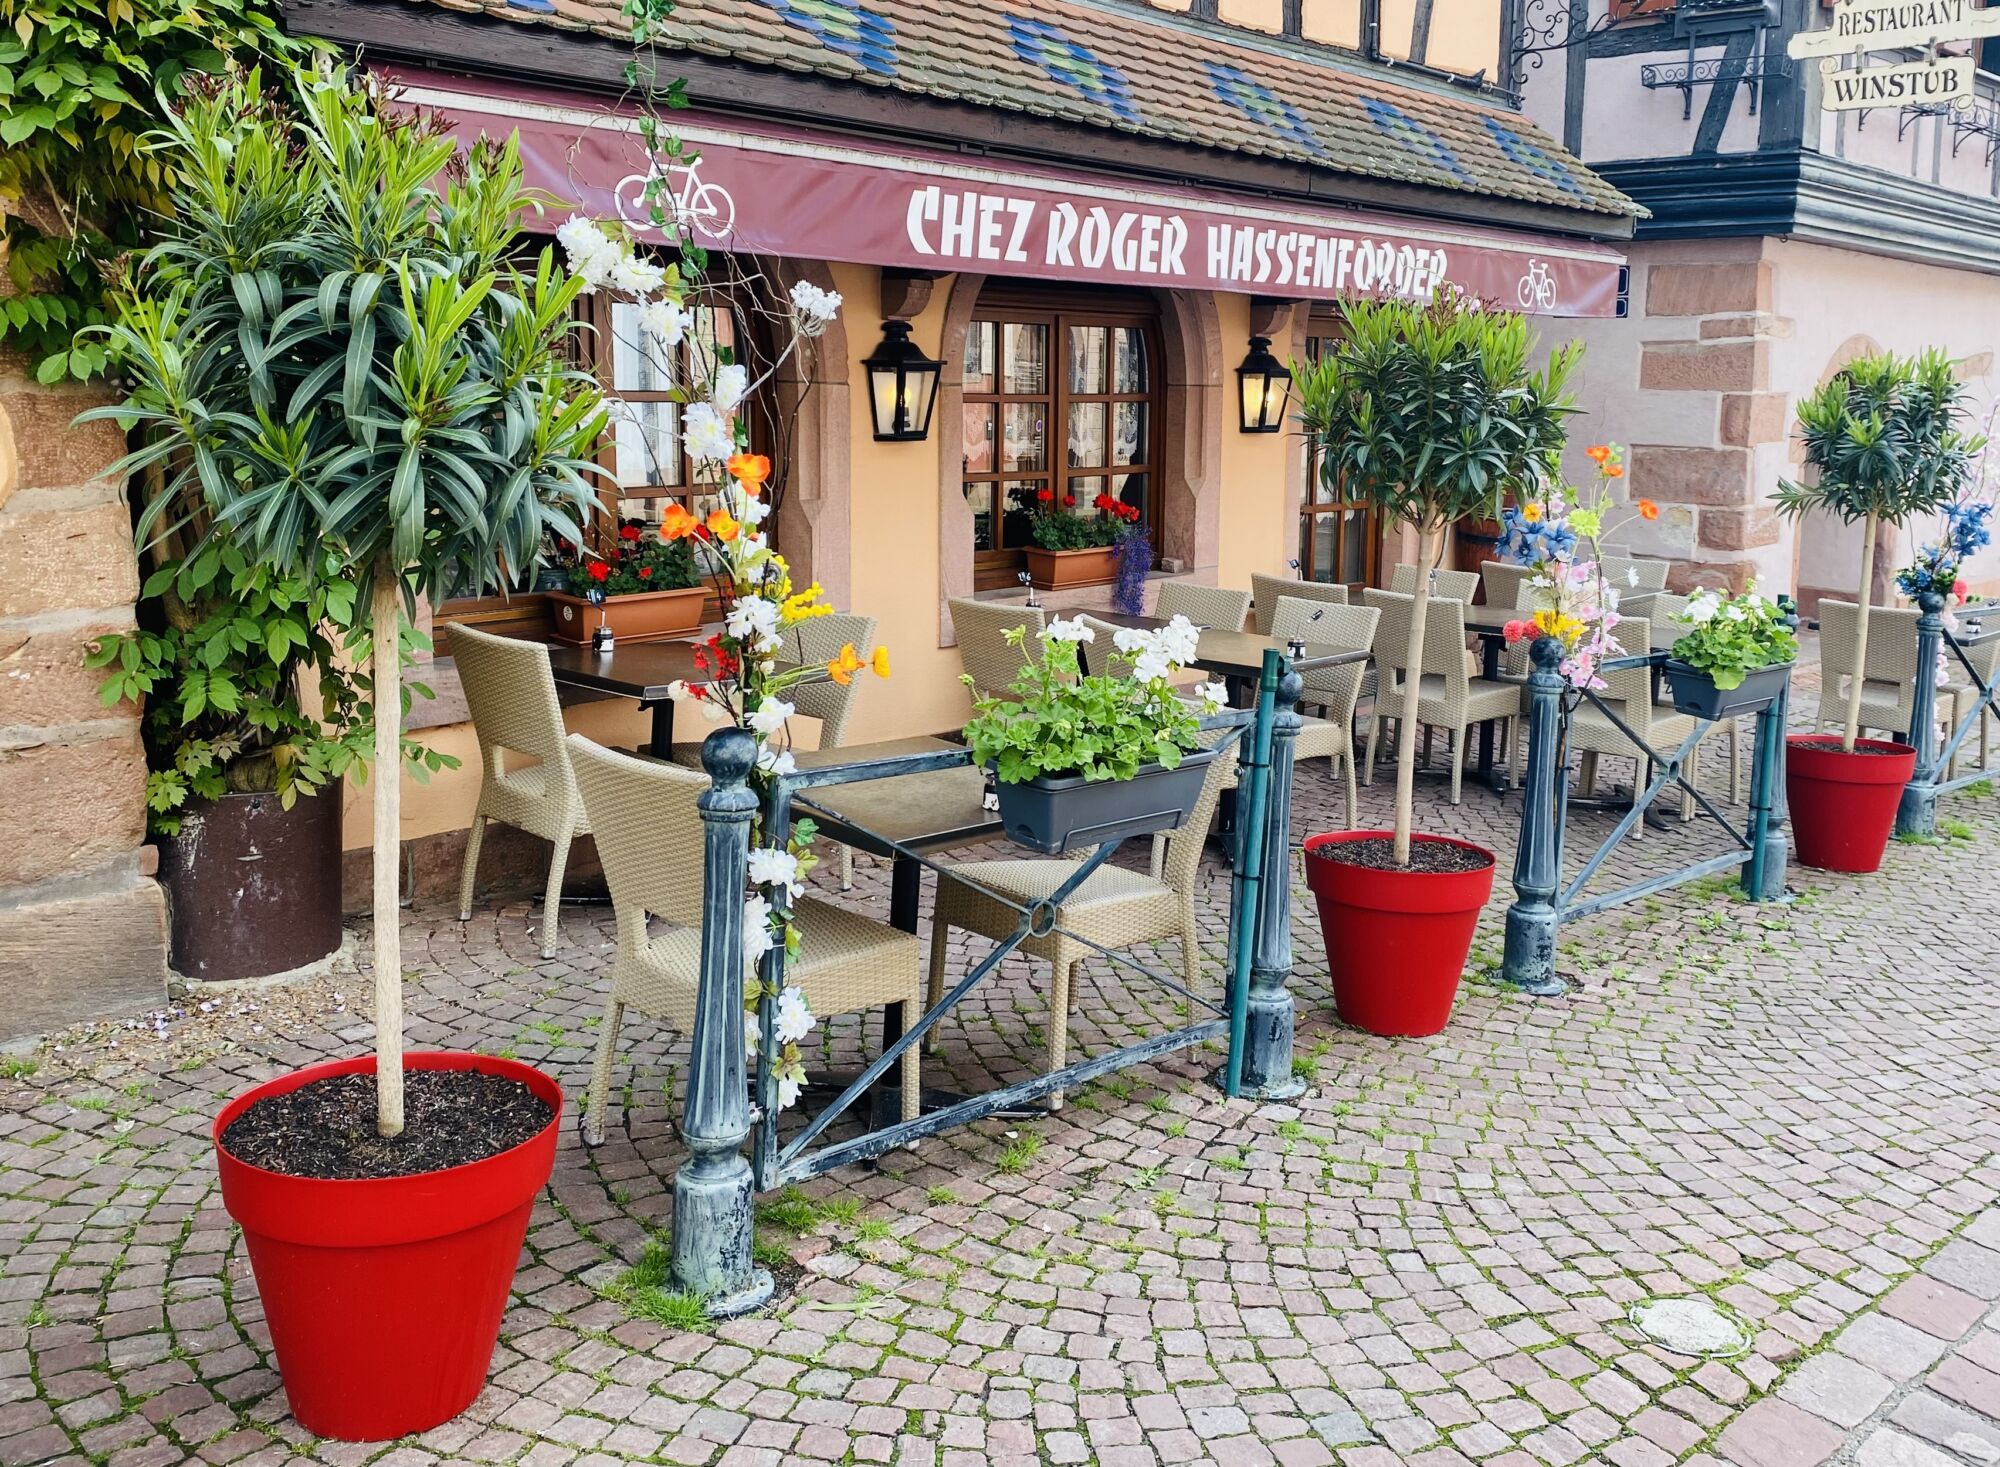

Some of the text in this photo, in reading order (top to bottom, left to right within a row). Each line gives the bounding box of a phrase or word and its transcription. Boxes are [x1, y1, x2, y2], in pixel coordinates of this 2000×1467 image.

[1838, 0, 1967, 37] RESTAURANT
[1834, 68, 1959, 103] WINSTUB
[906, 185, 1448, 297] CHEZ ROGER HASSENFORDER
